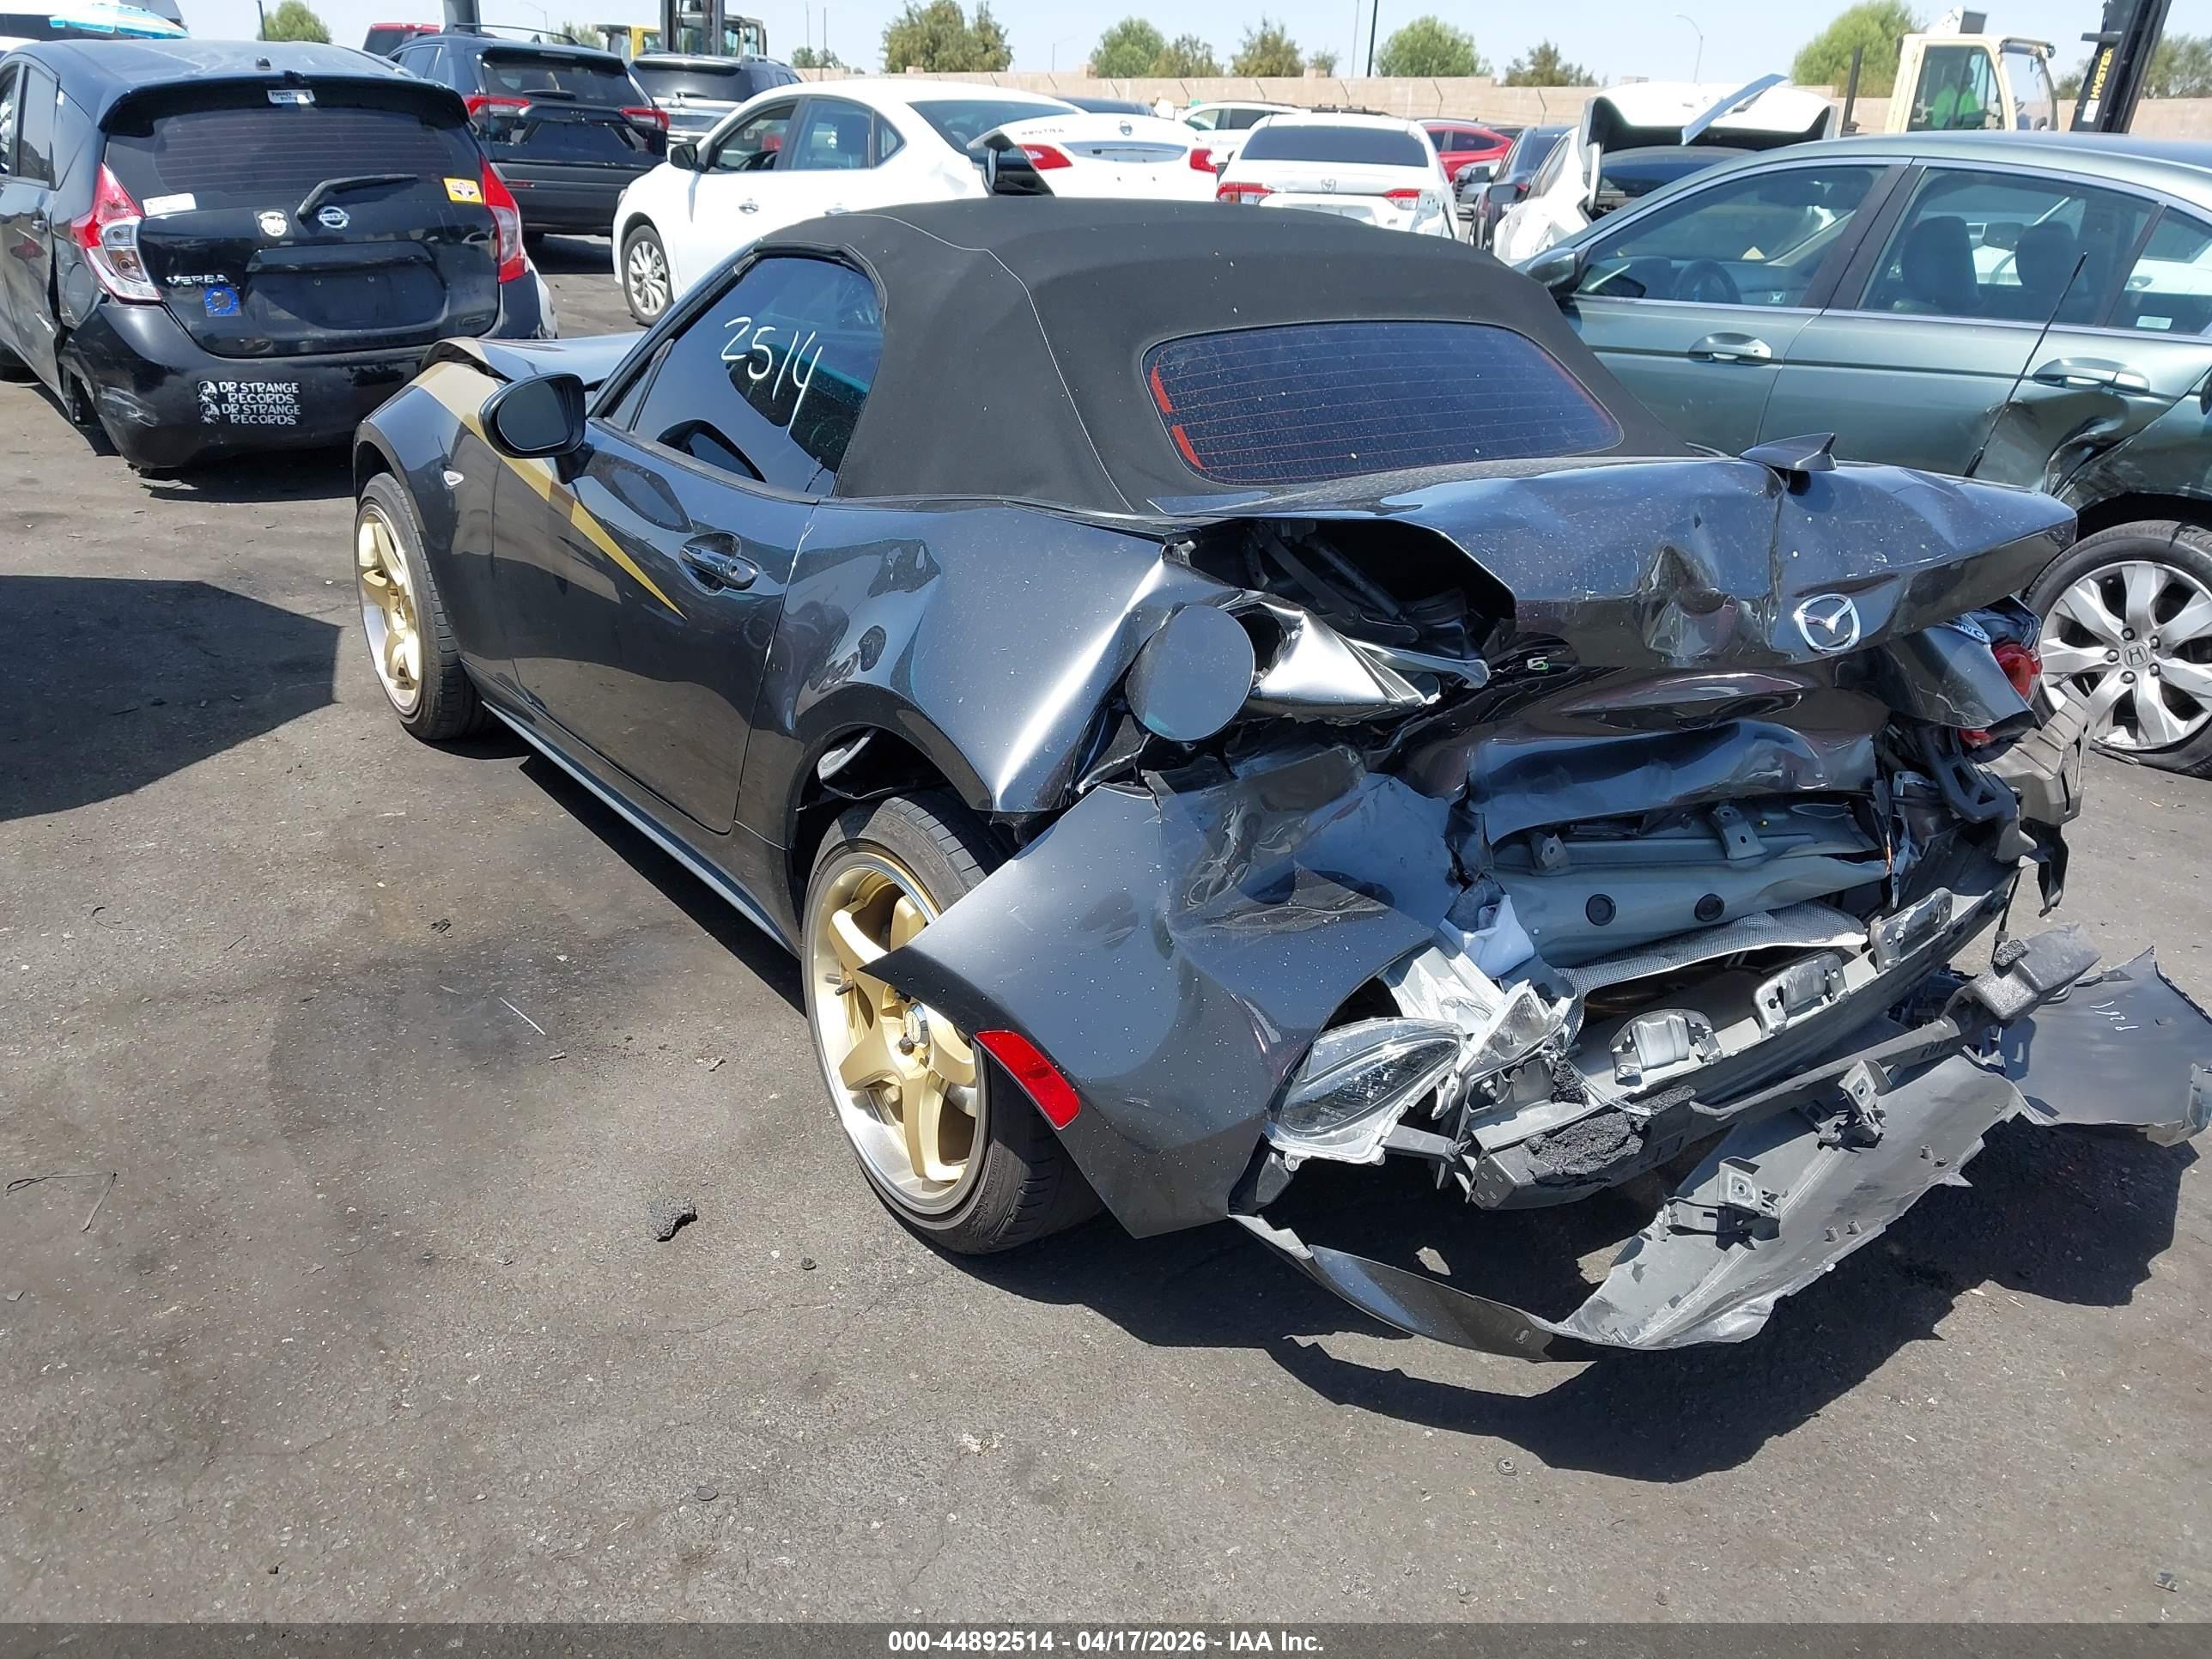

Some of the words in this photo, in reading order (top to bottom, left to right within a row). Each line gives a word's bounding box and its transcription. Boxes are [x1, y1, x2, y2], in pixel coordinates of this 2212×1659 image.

[2089, 46, 2114, 99] HYSTER
[720, 316, 823, 440] 2514
[218, 381, 238, 392] DR
[240, 381, 300, 393] STRANGE
[228, 392, 295, 404] RECORDS
[221, 404, 240, 414] DR
[242, 404, 301, 415] STRANGE
[229, 414, 297, 425] RECORDS
